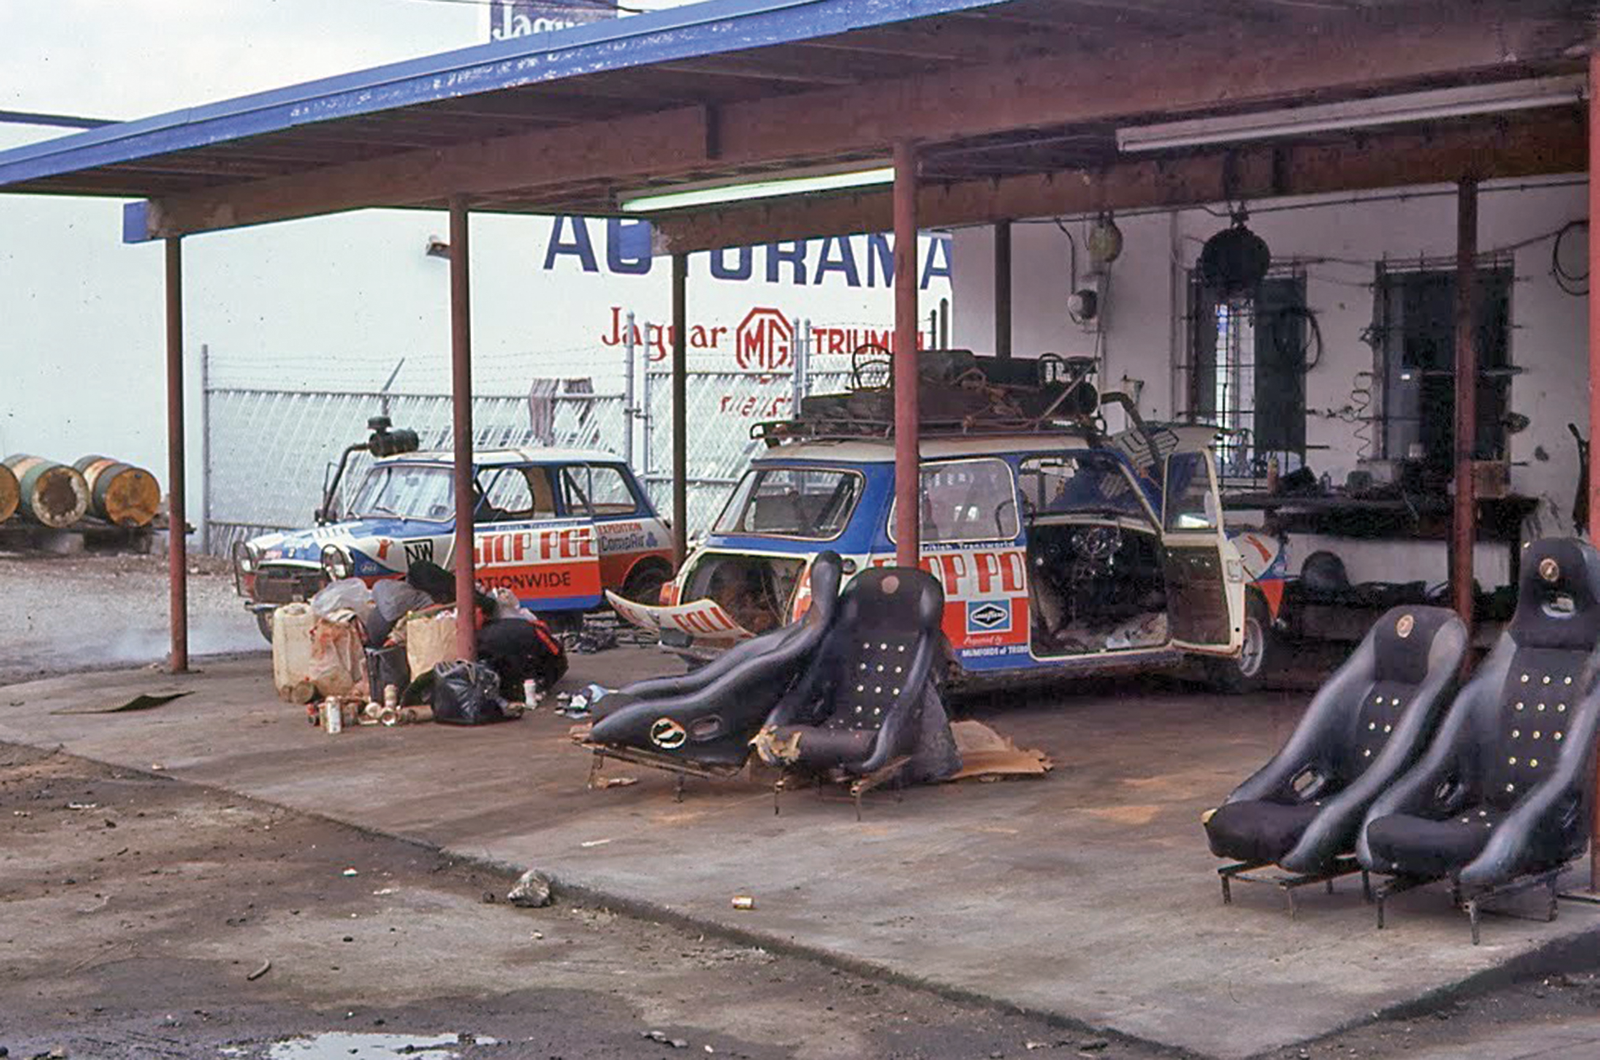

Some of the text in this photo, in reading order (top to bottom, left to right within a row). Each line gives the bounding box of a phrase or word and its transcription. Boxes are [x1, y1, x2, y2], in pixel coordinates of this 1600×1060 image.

[543, 214, 952, 290] AURAMA
[601, 306, 728, 362] Jagar
[742, 315, 790, 370] MG
[812, 329, 924, 356] TRIUM
[598, 522, 642, 535] EXPEDITION
[601, 533, 645, 552] CompAir
[474, 571, 571, 590] ATIONWIDE
